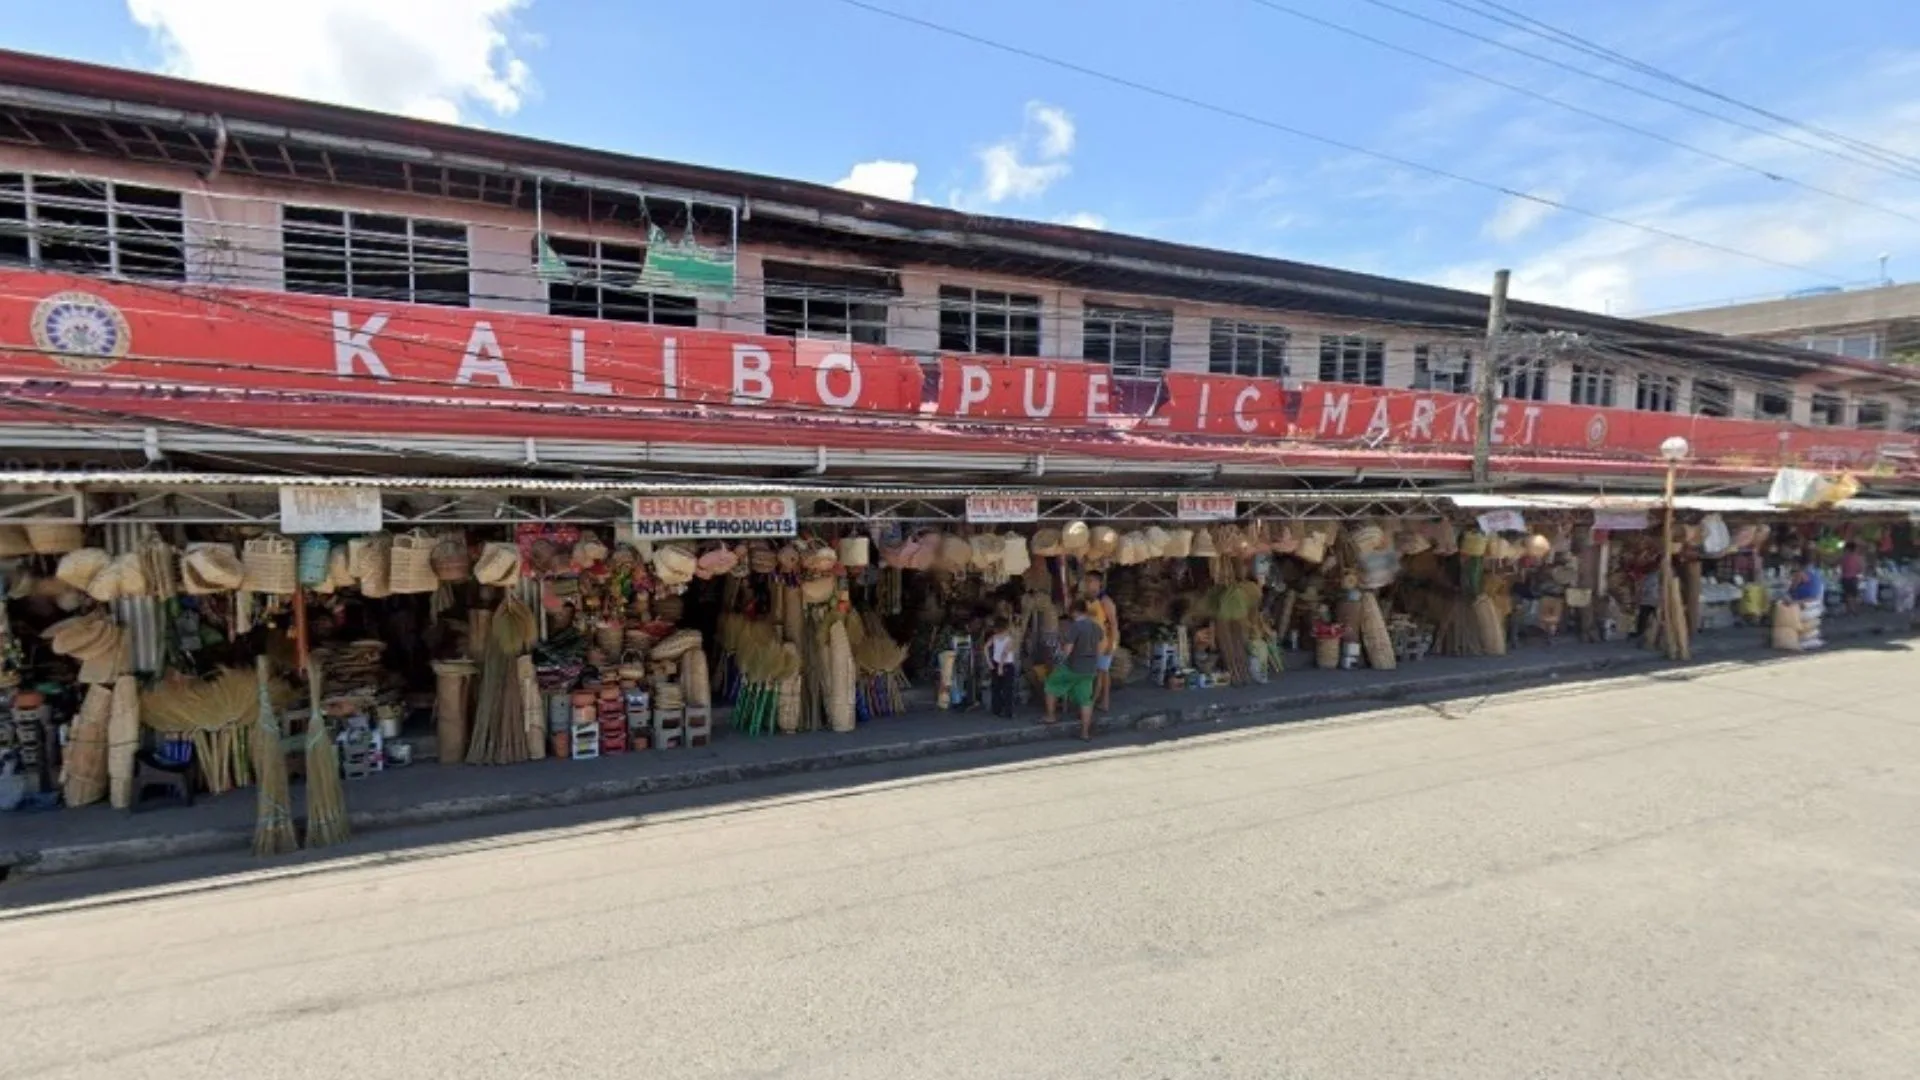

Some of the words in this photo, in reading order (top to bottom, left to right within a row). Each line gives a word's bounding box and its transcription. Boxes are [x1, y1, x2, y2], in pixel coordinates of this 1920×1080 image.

[332, 310, 862, 409] KALIBO
[956, 365, 1261, 432] PUIC
[1319, 392, 1542, 445] MARKET
[639, 519, 702, 534] NATIVE
[706, 519, 793, 534] PRODUCTS
